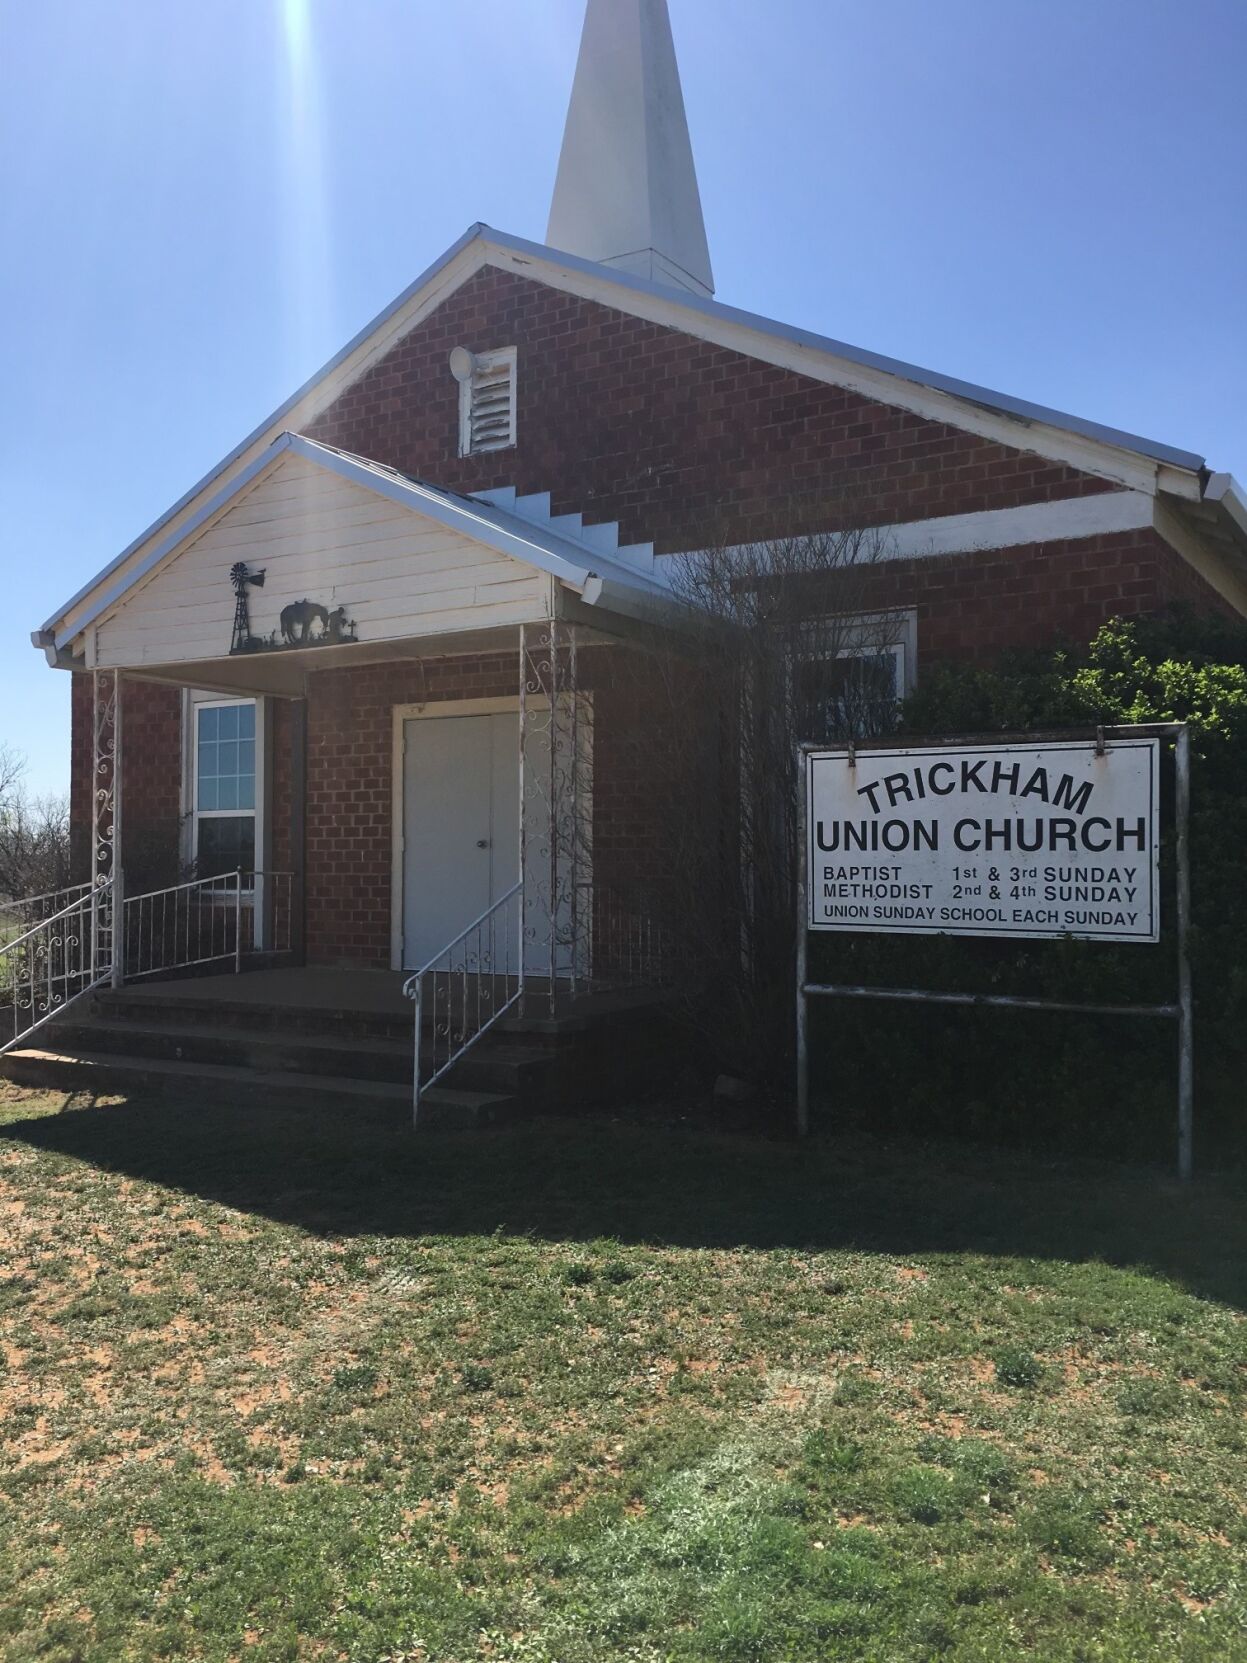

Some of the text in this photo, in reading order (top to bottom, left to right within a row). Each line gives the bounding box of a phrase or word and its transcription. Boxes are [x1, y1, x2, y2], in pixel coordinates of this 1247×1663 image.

[857, 760, 1094, 815] TRICKHAM
[817, 816, 1146, 852] UNION CHURCH
[824, 866, 1137, 883] BAPTIST 1st & 3rd SUNDAY
[824, 884, 1137, 903] METHODIST 2nd & 4th SUNDAY
[824, 905, 1138, 926] UNION SUNDAY SCHOOL EACH SUNDAY
